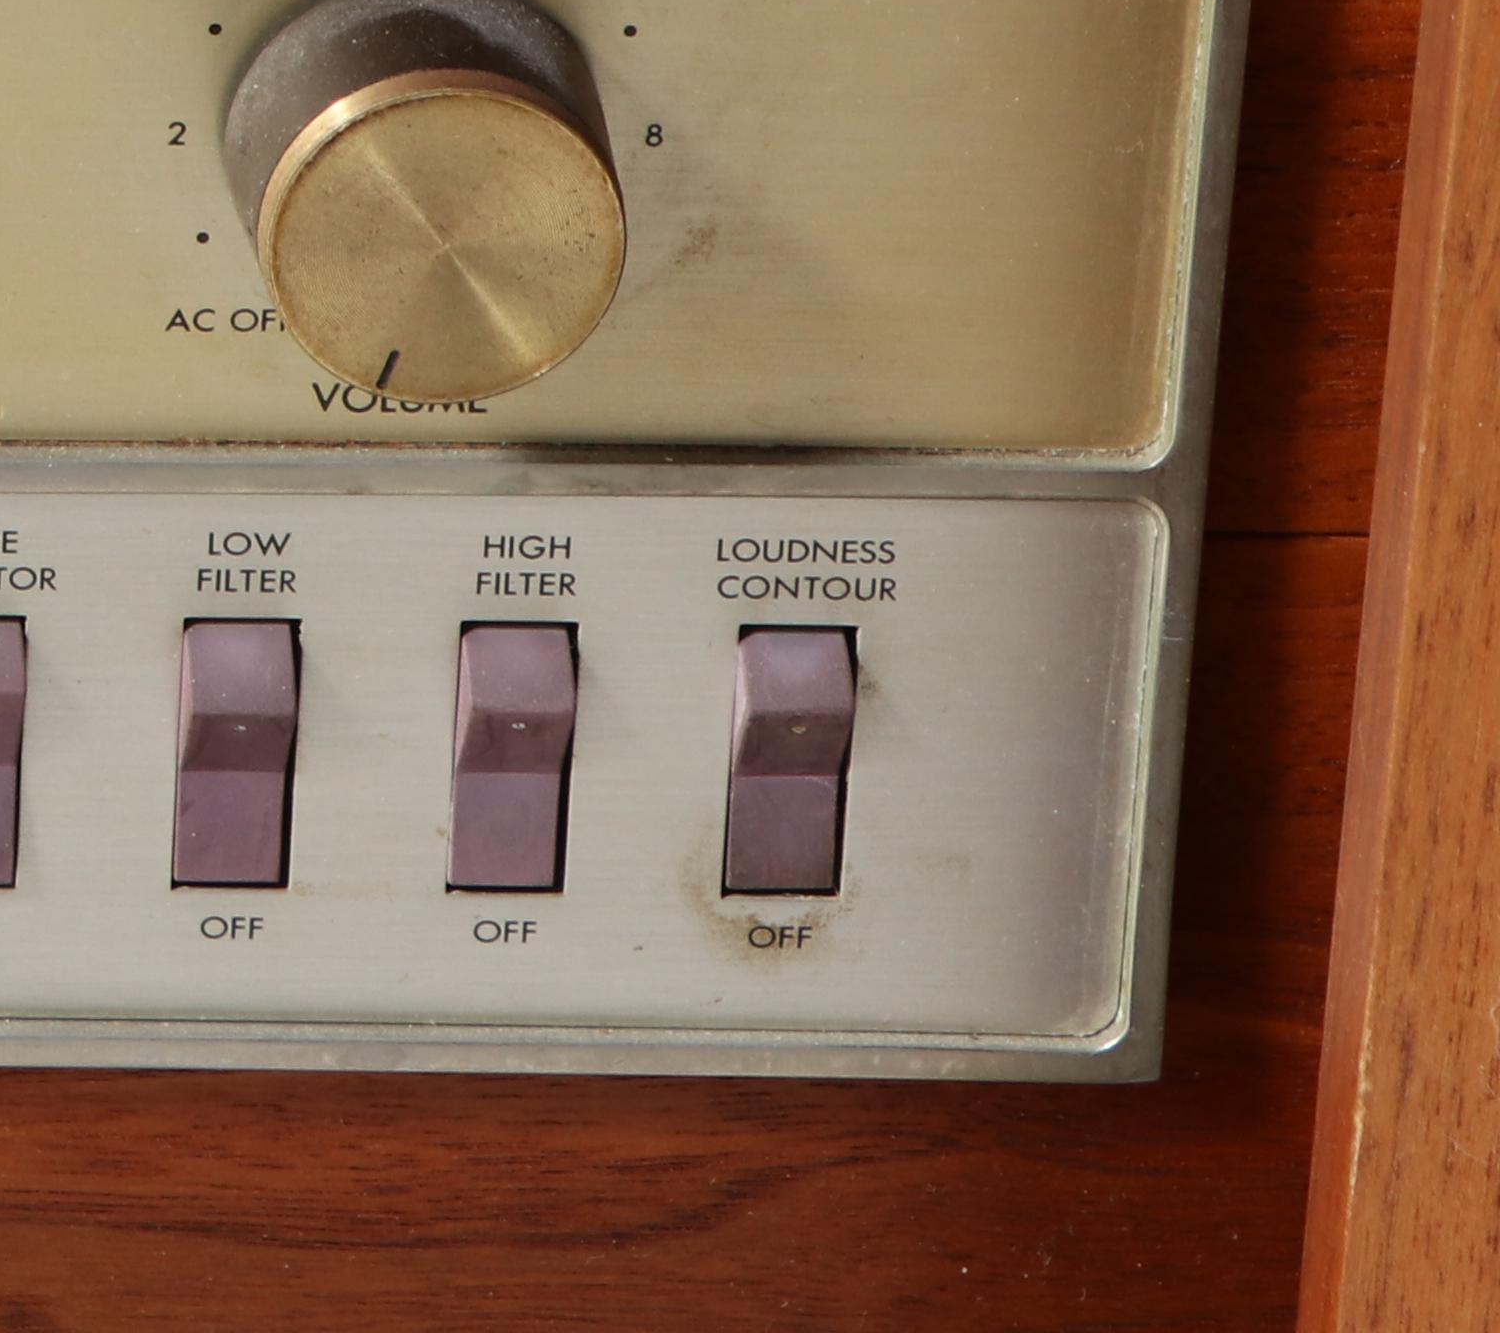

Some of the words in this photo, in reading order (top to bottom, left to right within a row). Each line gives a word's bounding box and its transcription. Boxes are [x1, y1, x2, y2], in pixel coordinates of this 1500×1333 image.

[168, 121, 187, 146] 2
[645, 123, 664, 148] 8
[165, 308, 216, 333] AC
[229, 308, 286, 334] OF
[208, 531, 291, 556] LOW
[483, 535, 571, 560] HIGH
[717, 538, 896, 565] LOUDNESS
[197, 568, 296, 593] FILTER
[476, 572, 576, 596] FILTER
[717, 575, 896, 602] CONTOUR
[200, 916, 264, 940] OFF
[473, 920, 537, 944] OFF
[747, 925, 813, 949] OFF
